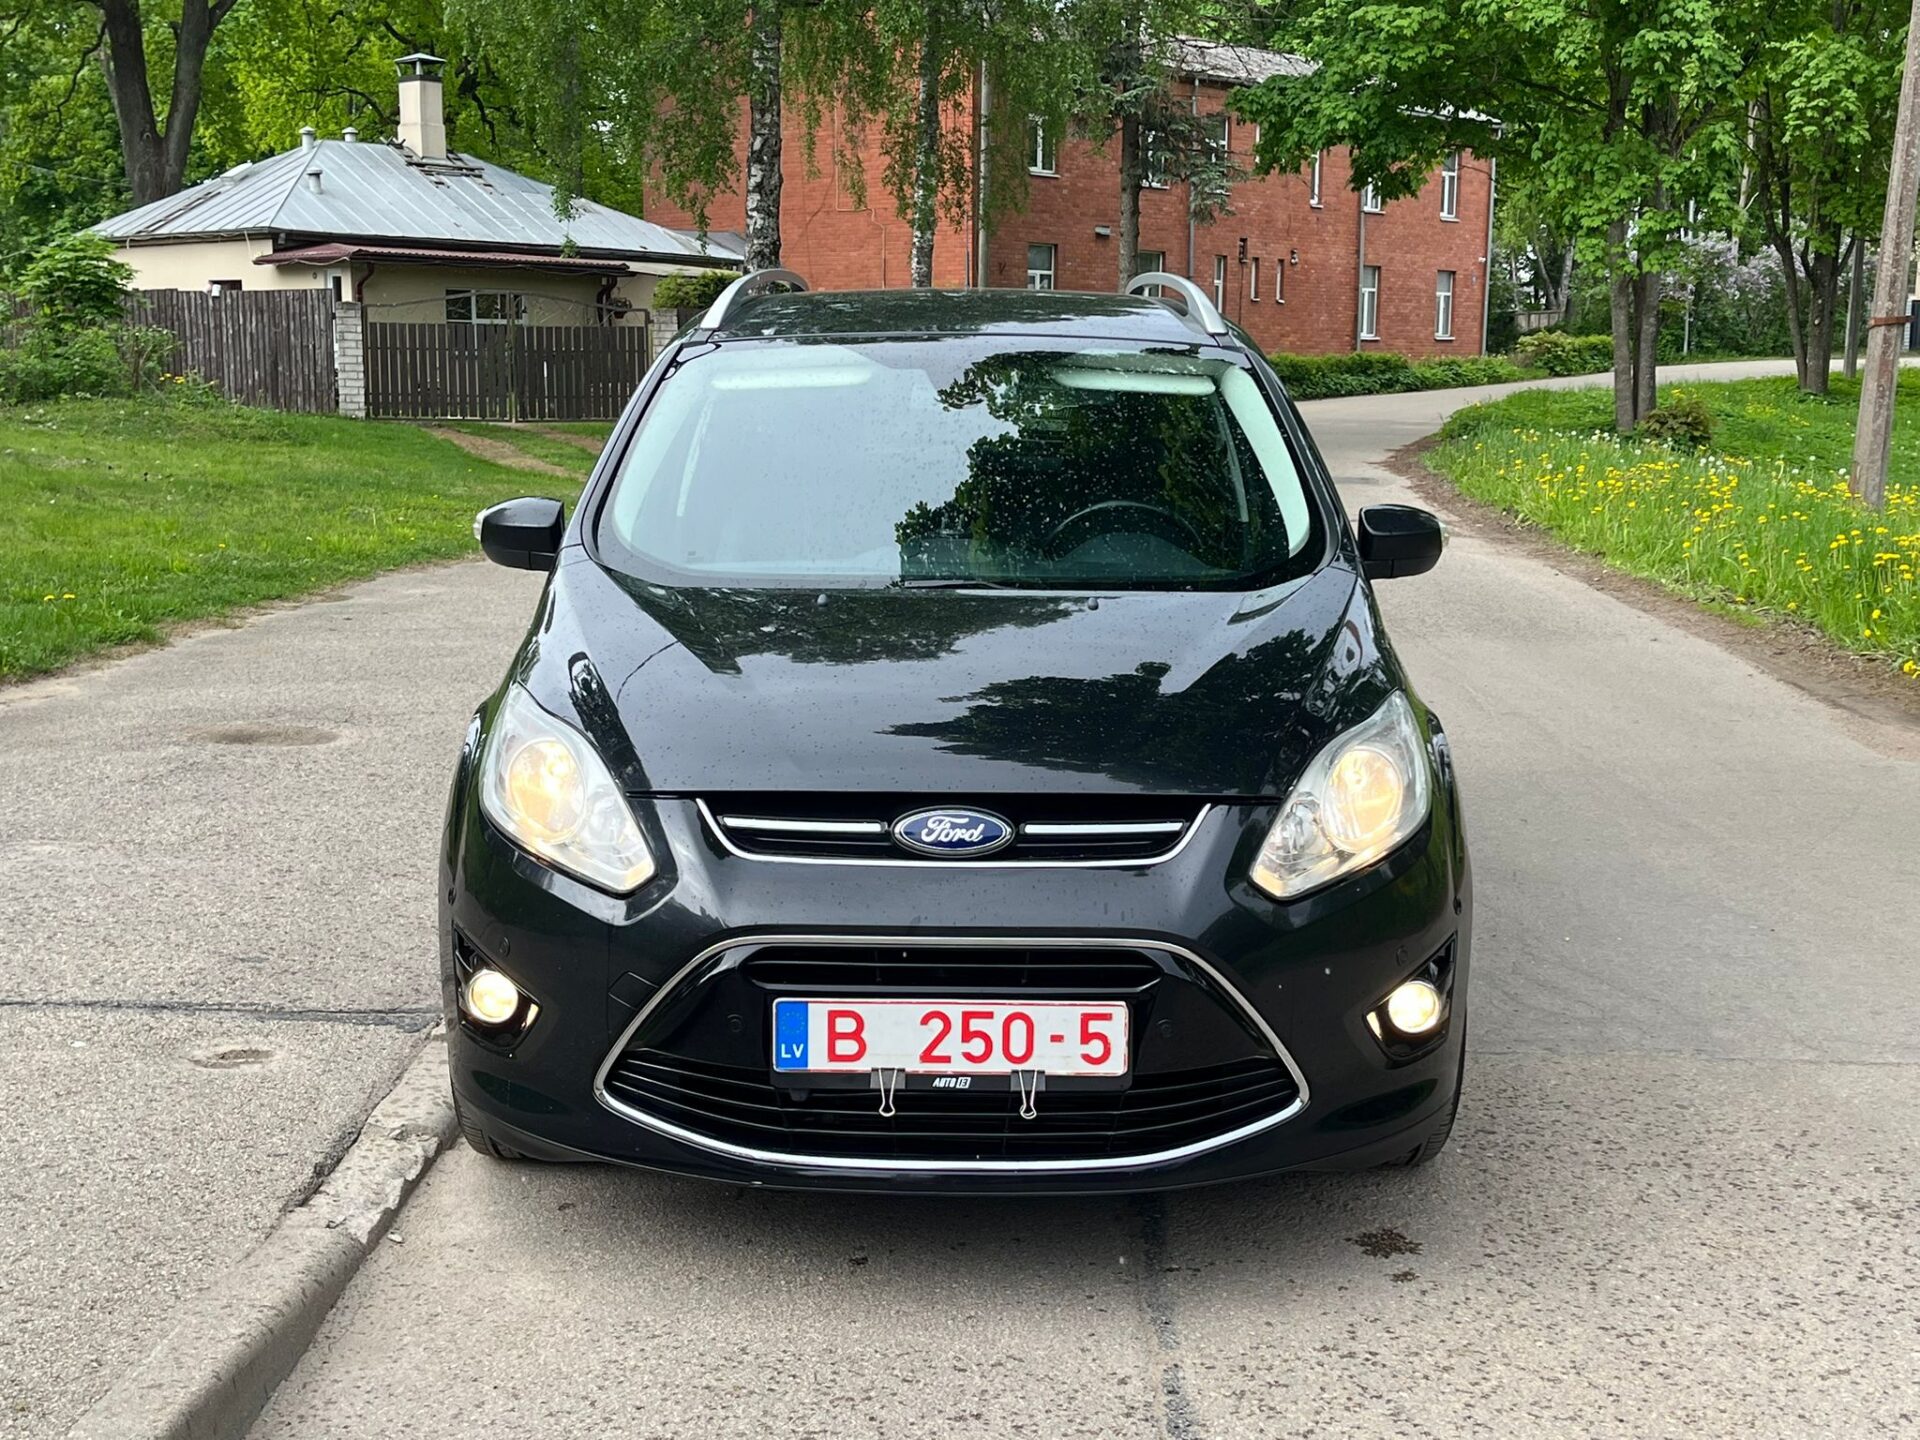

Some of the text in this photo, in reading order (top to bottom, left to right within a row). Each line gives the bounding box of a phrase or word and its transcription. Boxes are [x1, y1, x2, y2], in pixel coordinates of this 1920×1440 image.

[921, 815, 985, 843] Ford
[827, 1009, 1113, 1066] B 250-5
[781, 1043, 804, 1058] LV
[932, 1077, 957, 1089] AUTO
